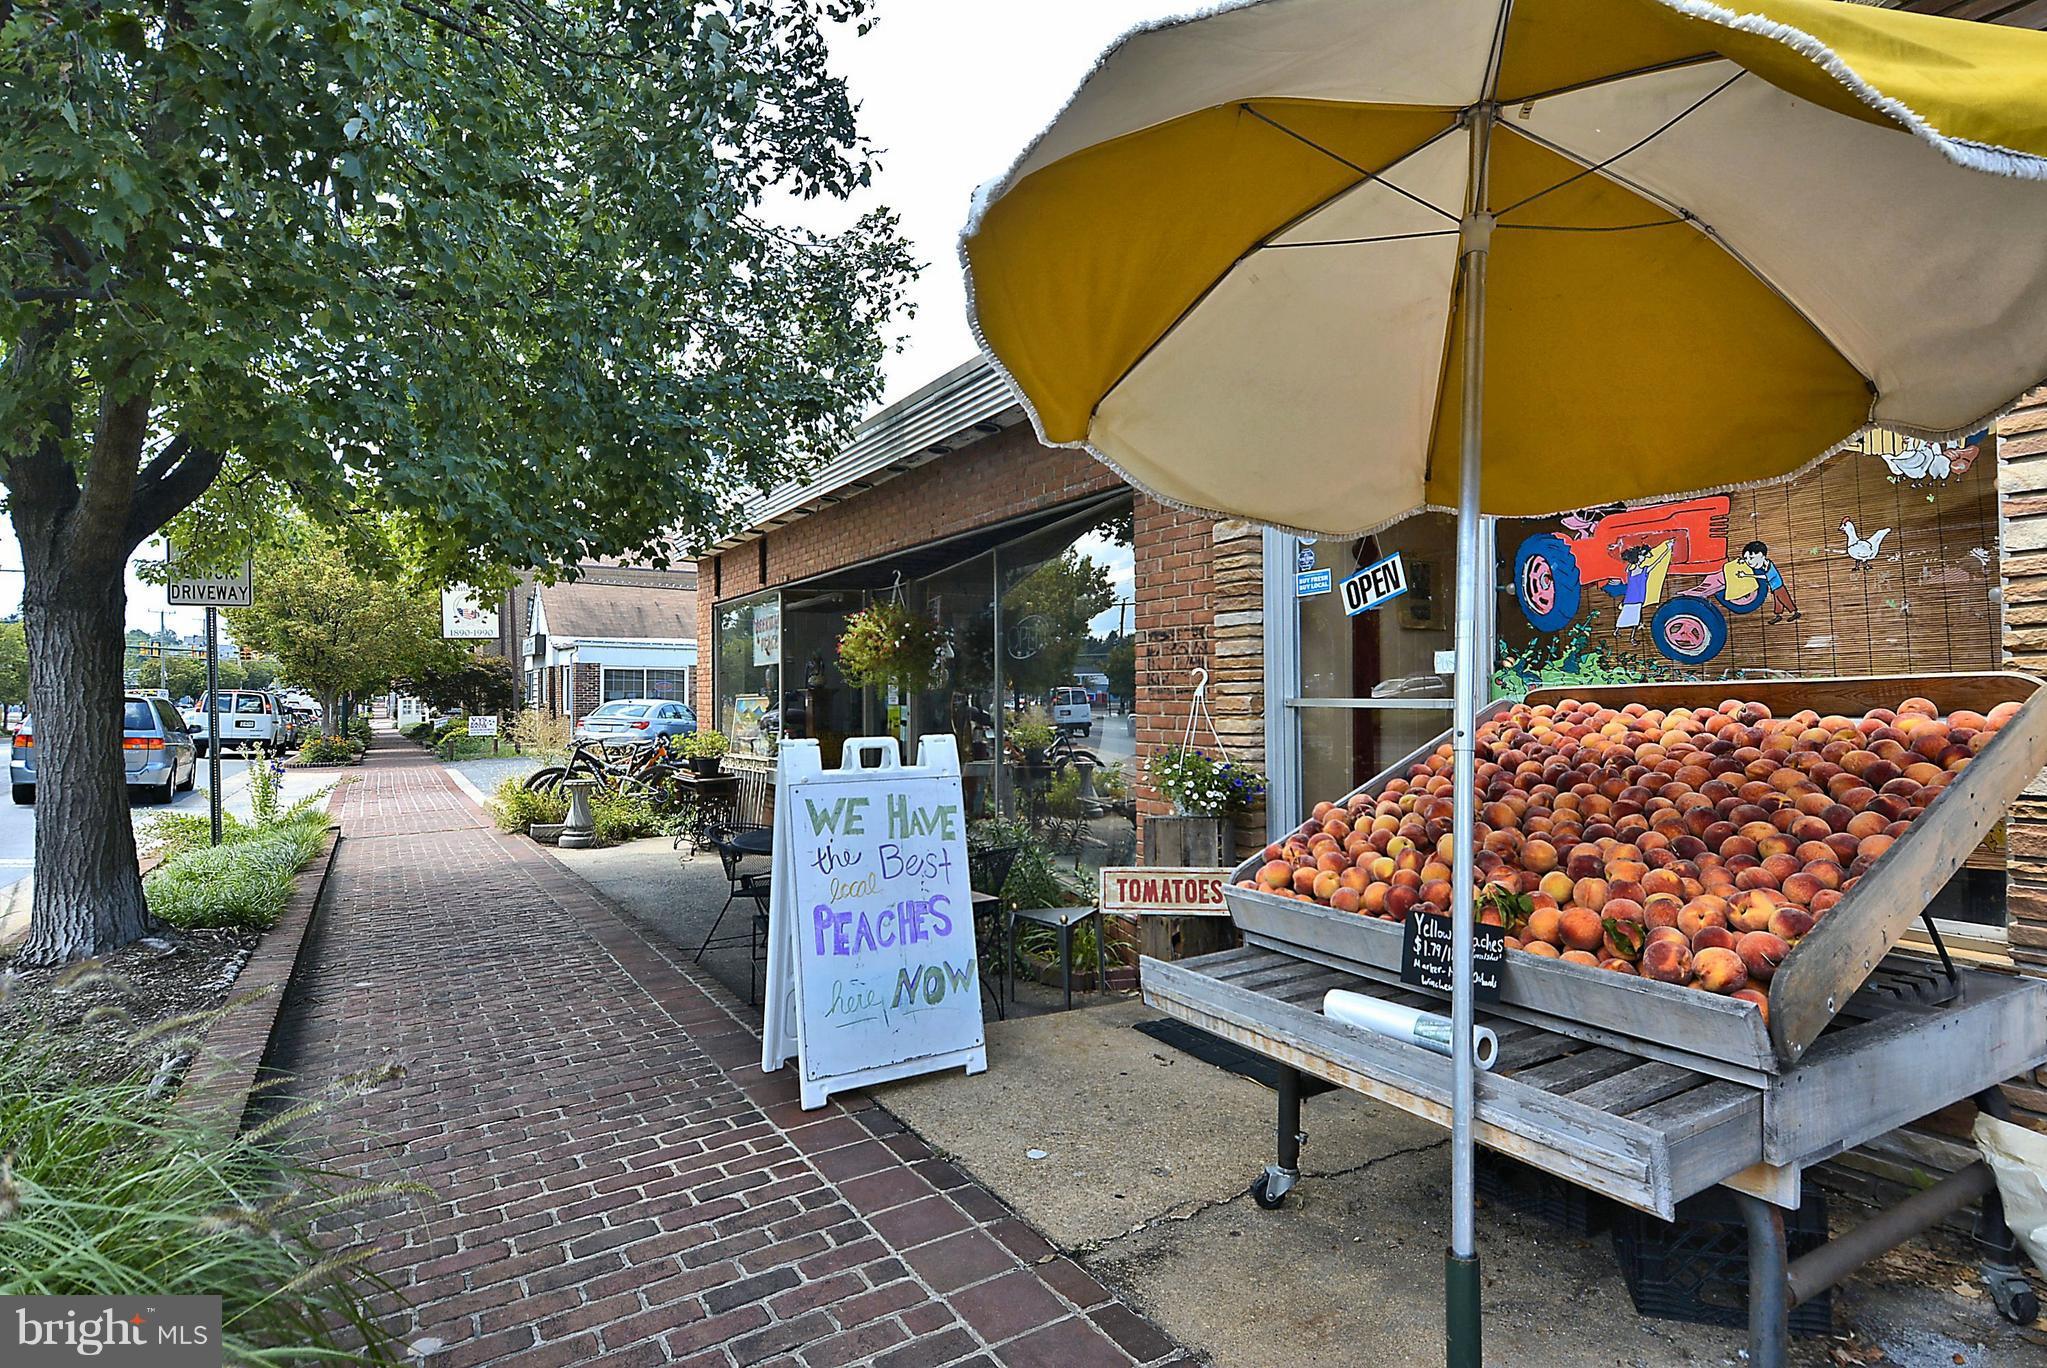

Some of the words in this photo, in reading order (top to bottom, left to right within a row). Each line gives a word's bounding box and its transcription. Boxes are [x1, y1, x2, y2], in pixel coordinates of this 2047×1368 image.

[171, 585, 248, 600] DRIVEWAY
[1310, 575, 1328, 583] FRESH
[1346, 560, 1401, 609] OPEN
[450, 629, 493, 637] 1890-1990
[1436, 653, 1455, 673] PUS
[805, 797, 870, 836] WE
[887, 793, 957, 840] HAVE
[811, 845, 862, 875] the
[879, 844, 951, 884] Best
[830, 872, 882, 904] local
[1116, 878, 1224, 904] TOMATOES
[812, 894, 953, 956] PEACHES
[1414, 912, 1452, 940] Yellow
[1473, 933, 1504, 953] aches
[890, 958, 976, 1009] NOW
